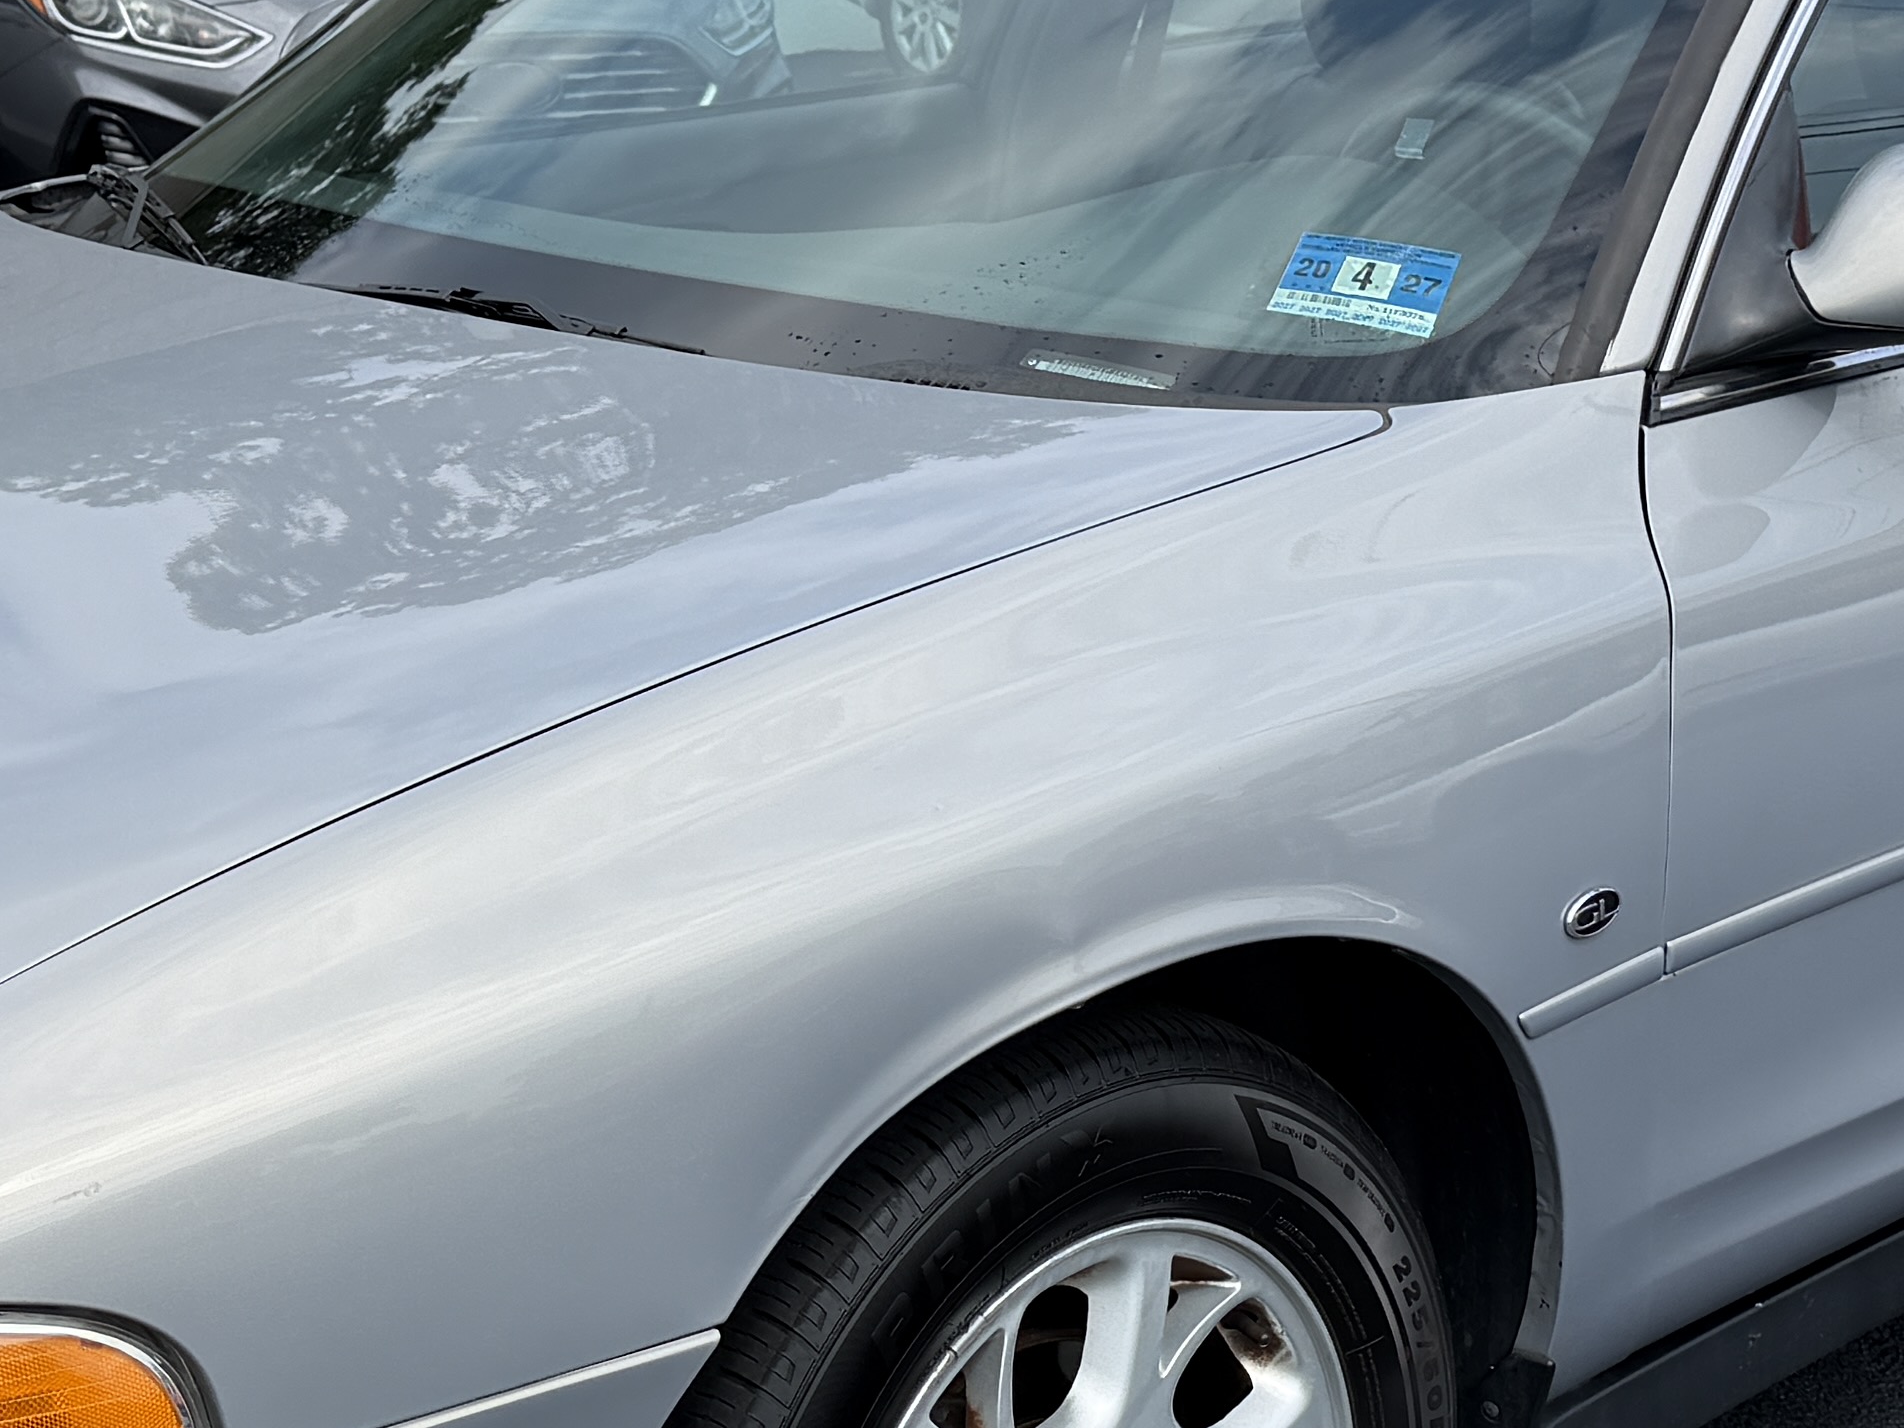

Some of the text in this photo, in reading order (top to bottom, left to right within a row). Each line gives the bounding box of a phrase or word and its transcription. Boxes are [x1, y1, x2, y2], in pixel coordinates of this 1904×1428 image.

[1294, 257, 1443, 298] 20 4 27
